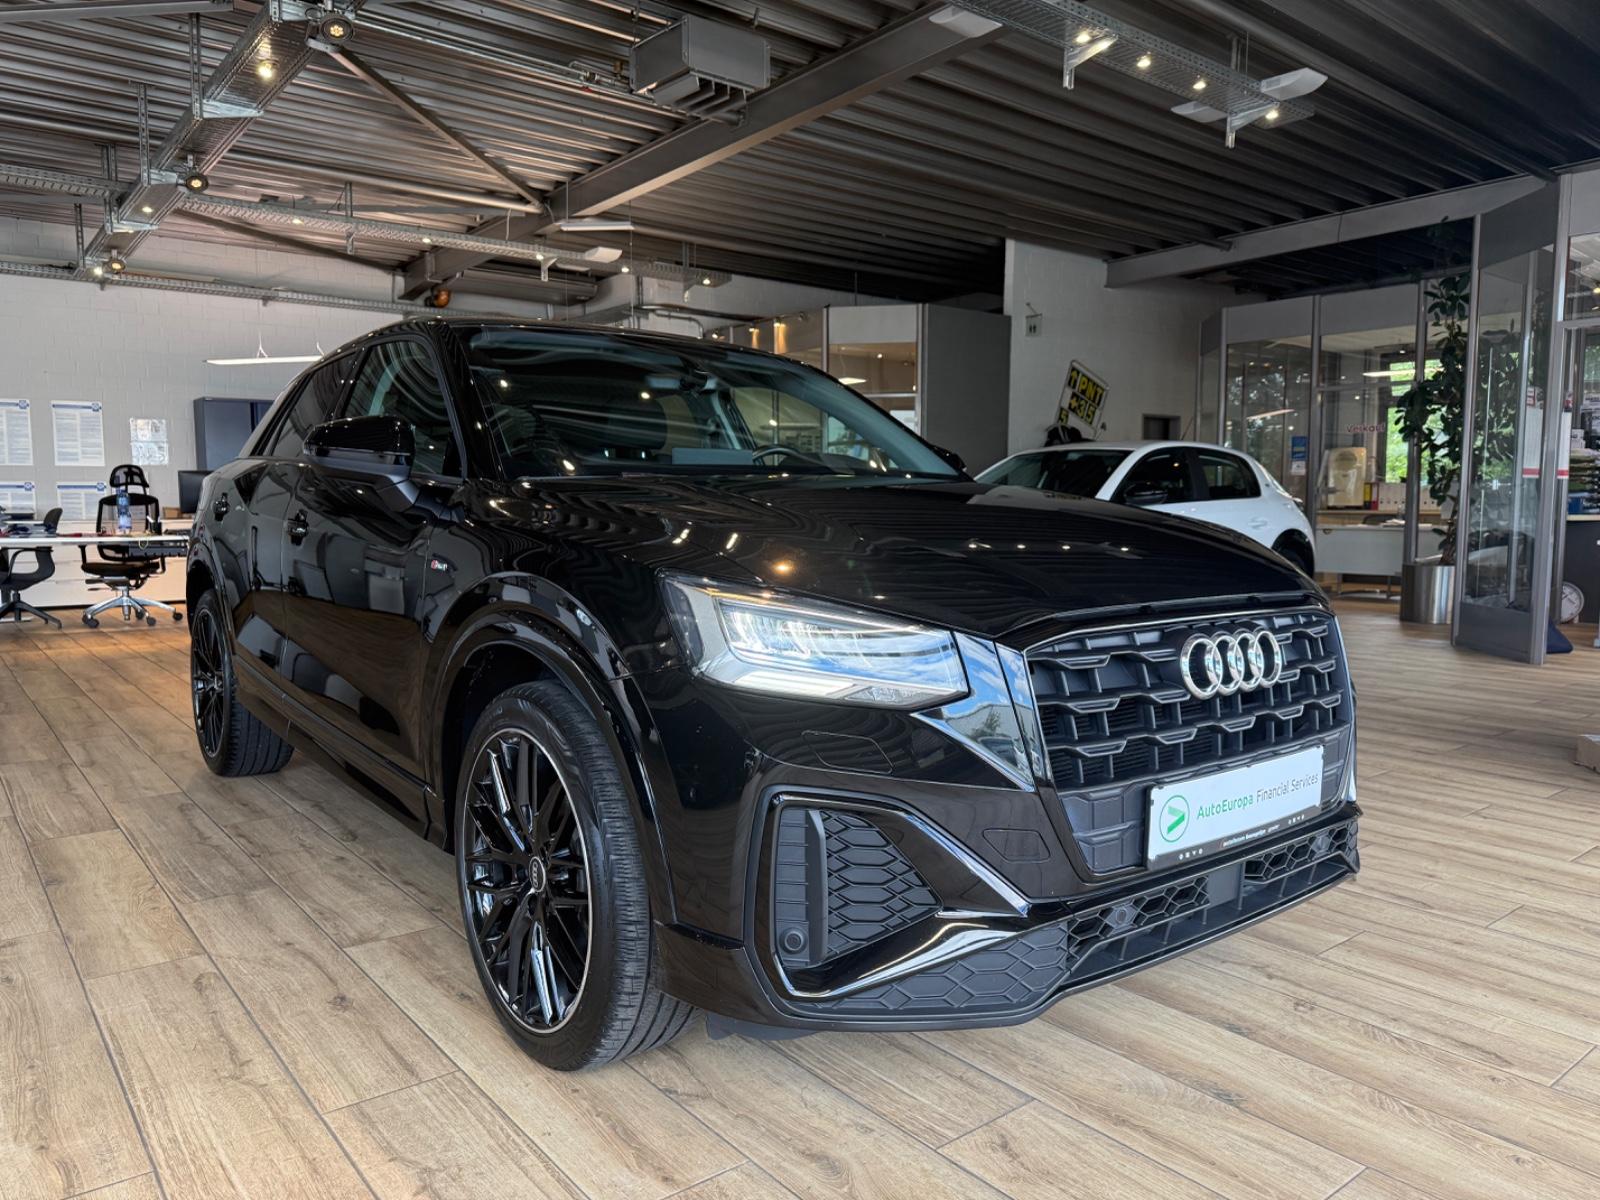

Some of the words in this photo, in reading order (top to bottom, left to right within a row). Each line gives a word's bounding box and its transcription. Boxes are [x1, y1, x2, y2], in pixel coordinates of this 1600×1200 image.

[1197, 793, 1254, 819] AutoEuropa
[1256, 783, 1290, 802] Financial
[1291, 774, 1319, 793] Services
